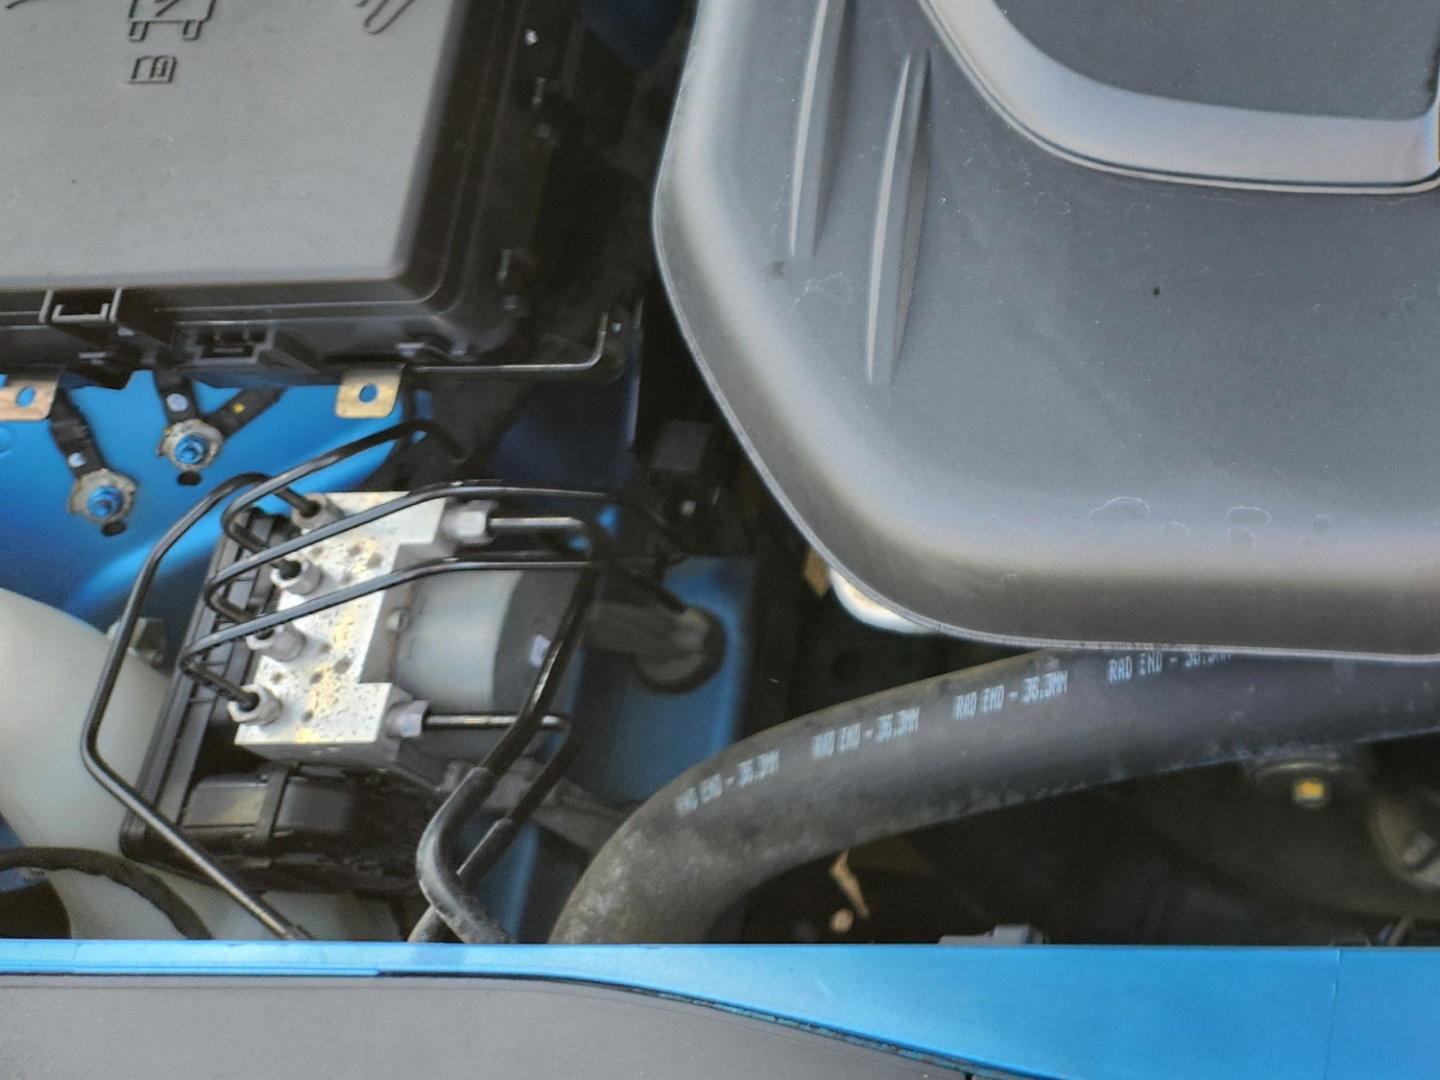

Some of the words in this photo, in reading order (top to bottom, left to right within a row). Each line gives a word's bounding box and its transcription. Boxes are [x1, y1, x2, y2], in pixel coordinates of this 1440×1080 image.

[1107, 656, 1132, 683] RAD
[1138, 651, 1163, 676] END
[952, 691, 977, 720] RAD
[980, 685, 1005, 714] END
